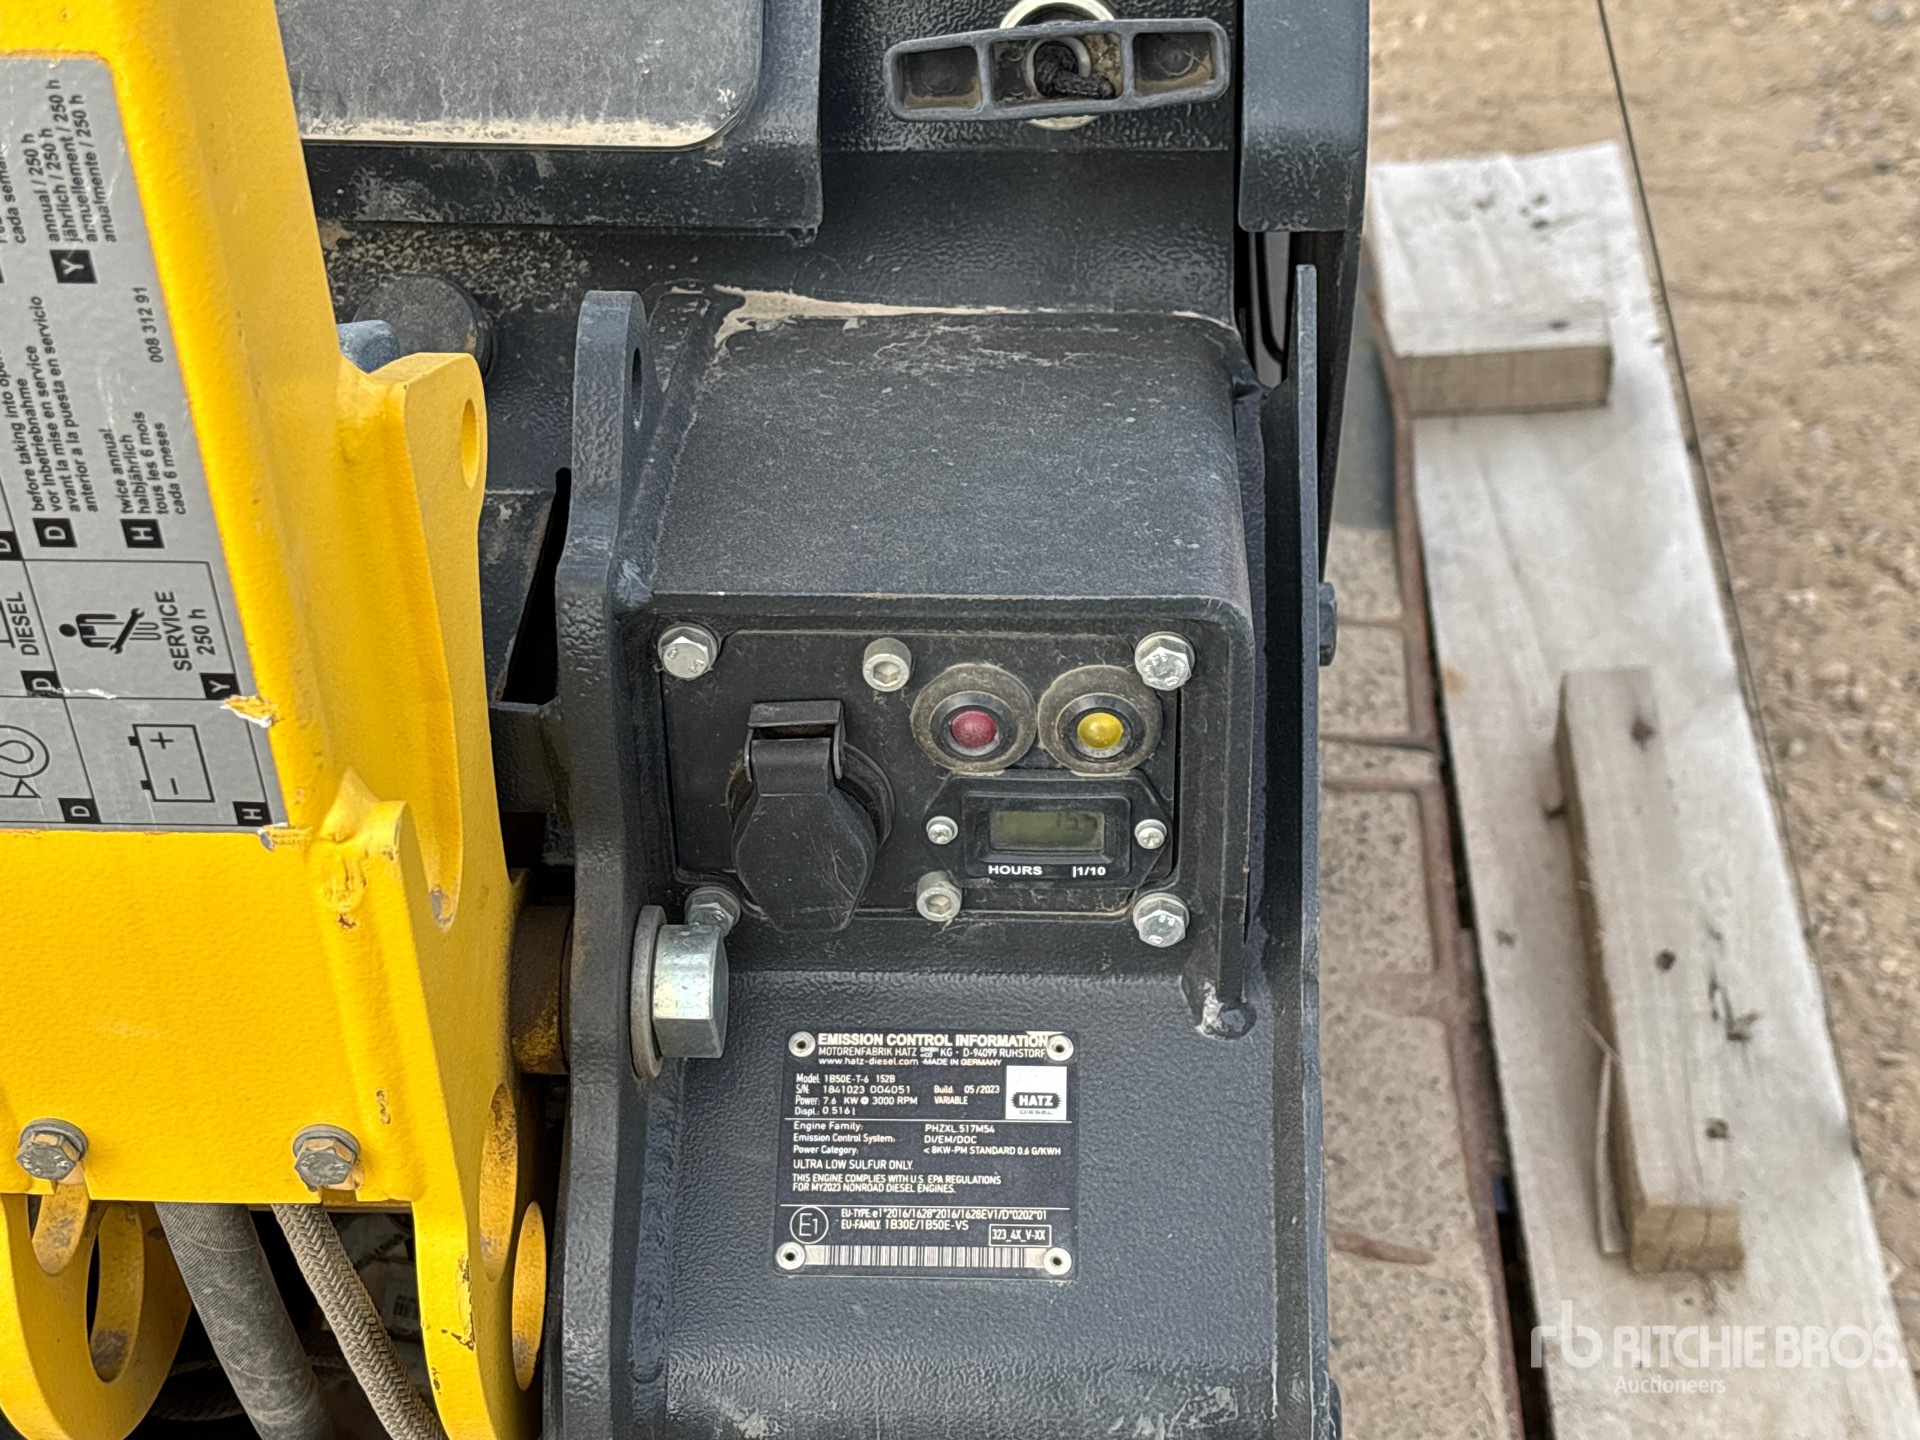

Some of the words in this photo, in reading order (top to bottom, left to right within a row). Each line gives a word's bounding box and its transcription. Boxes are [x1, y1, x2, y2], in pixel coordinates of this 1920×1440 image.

[46, 79, 61, 89] h
[49, 94, 69, 123] 250
[69, 94, 85, 104] h
[38, 128, 53, 138] h
[72, 110, 92, 138] 250
[21, 134, 36, 143] h
[24, 149, 43, 176] 250
[42, 143, 61, 171] 250
[59, 136, 98, 242] annuellement
[84, 152, 117, 242] anualmente
[6, 207, 26, 243] cada
[33, 189, 60, 242] annual
[53, 184, 84, 243] jährlich
[132, 287, 150, 303] 91
[29, 296, 56, 354] servicio
[137, 308, 157, 333] 312
[145, 338, 164, 362] 008
[26, 345, 49, 397] service
[47, 358, 62, 376] en
[2, 391, 19, 418] into
[41, 401, 55, 418] en
[52, 380, 79, 427] puesta
[17, 378, 56, 486] Inbetriebnahme
[47, 423, 65, 455] mise
[67, 432, 79, 444] la
[131, 411, 152, 444] mois
[11, 423, 32, 465] taking
[140, 449, 154, 458] 6
[154, 422, 175, 468] meses
[56, 459, 69, 471] la
[120, 434, 152, 514] halbjährlich
[146, 461, 160, 481] les
[163, 470, 178, 479] 6
[24, 469, 45, 511] before
[59, 475, 81, 512] avant
[74, 460, 98, 512] anterior
[116, 479, 134, 514] twice
[168, 482, 186, 514] cada
[48, 490, 63, 512] vor
[152, 485, 169, 514] tous
[6, 591, 40, 656] DIESEL
[188, 609, 207, 619] h
[154, 590, 193, 671] SERVICE
[190, 625, 217, 655] 250
[988, 865, 1043, 876] HOURS
[818, 1033, 883, 1046] EMISSION
[886, 1033, 953, 1046] CONTROL
[955, 1034, 1048, 1048] INFORMATION
[818, 1047, 893, 1057] MOTORENFABRIK
[894, 1047, 917, 1057] HATZ
[940, 1048, 953, 1058] KG
[963, 1048, 997, 1058] D-94099
[999, 1048, 1046, 1058] RUHSTORF
[818, 1057, 919, 1066] www.hatz-diesel.com
[950, 1058, 959, 1066] IN
[960, 1058, 1002, 1067] GERMANY
[823, 1085, 866, 1094] 1841023
[869, 1085, 911, 1094] 004051
[824, 1074, 869, 1083] 1B50E-T-6
[876, 1074, 896, 1083] 152B
[822, 1106, 851, 1115] 0.516
[823, 1097, 837, 1105] 7.6
[843, 1096, 859, 1105] KW
[872, 1096, 895, 1105] 3000
[897, 1097, 918, 1105] RPM
[934, 1096, 968, 1105] VARIABLE
[1018, 1095, 1054, 1107] HATZ
[793, 1121, 827, 1132] Engine
[793, 1133, 830, 1142] Emission
[832, 1133, 861, 1142] Control
[923, 1135, 978, 1144] DI/EM/DOC
[793, 1145, 818, 1154] Power
[931, 1146, 968, 1154] 8KW-PM
[969, 1146, 1015, 1155] STANDARD
[1017, 1147, 1029, 1155] 0.6
[1031, 1147, 1061, 1156] G/KWH
[793, 1159, 823, 1169] ULTRA
[825, 1159, 847, 1169] LOW
[849, 1159, 887, 1170] SULFUR
[792, 1173, 811, 1182] THIS
[812, 1173, 843, 1182] ENGINE
[845, 1174, 886, 1183] COMPLIES
[888, 1174, 909, 1183] WITH
[928, 1175, 945, 1184] EPA
[945, 1175, 1001, 1185] REGULATIONS
[792, 1182, 809, 1191] FOR
[811, 1183, 841, 1192] MY2023
[842, 1183, 885, 1192] NONROAD
[886, 1184, 915, 1193] DIESEL
[798, 1212, 818, 1237] E1
[885, 1219, 969, 1231] 1B30E/1B50E-VS
